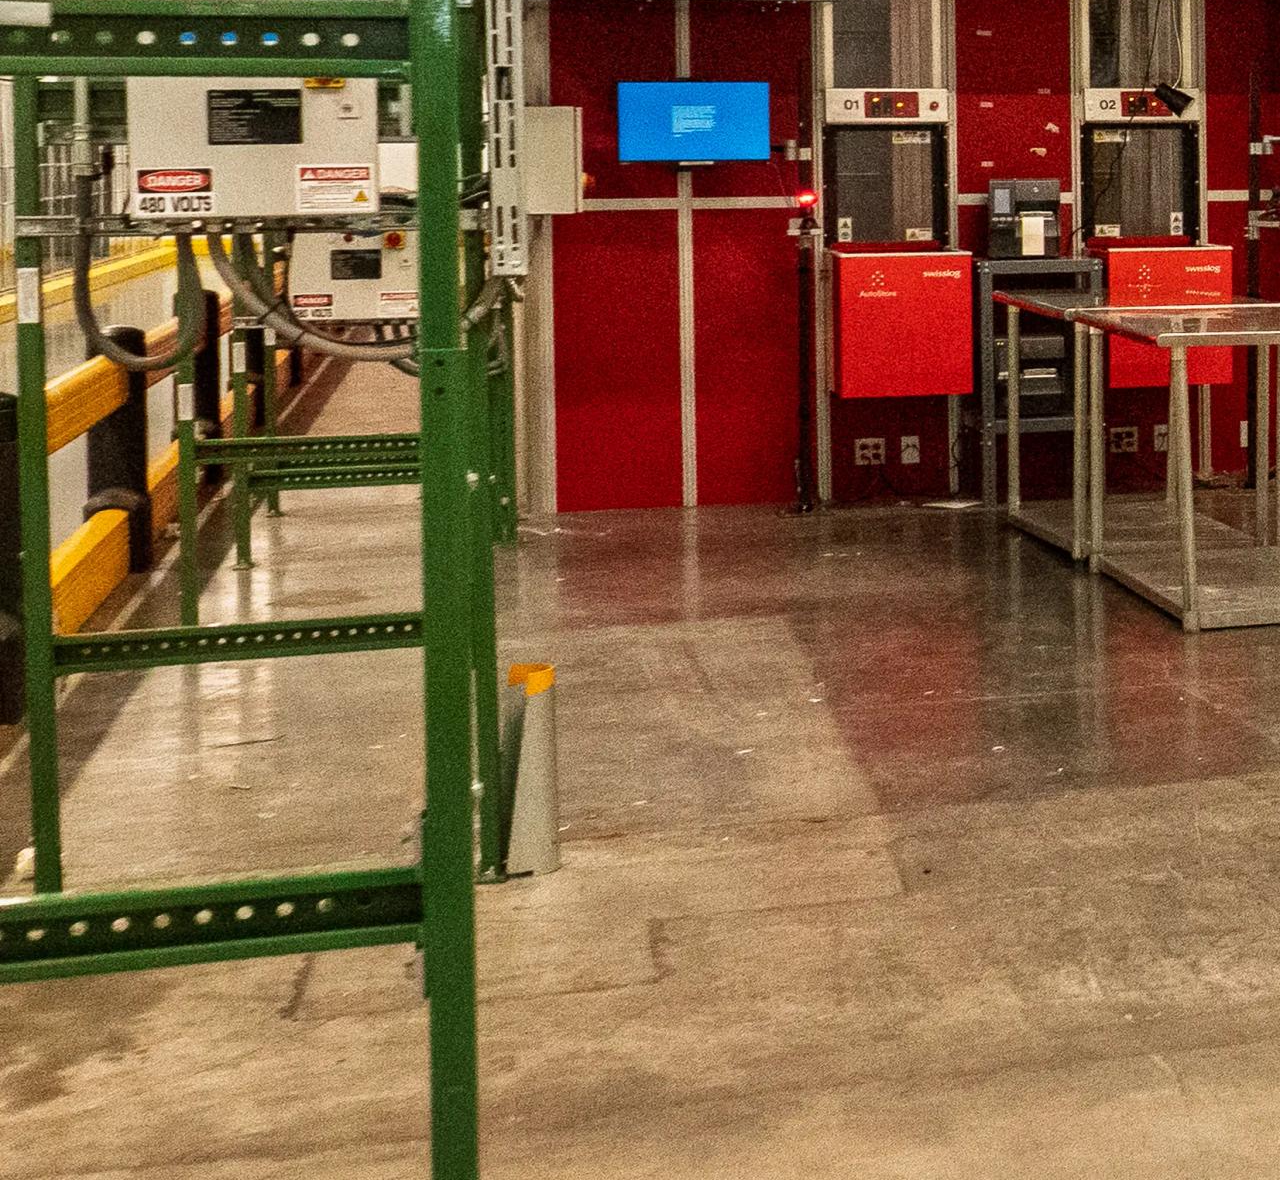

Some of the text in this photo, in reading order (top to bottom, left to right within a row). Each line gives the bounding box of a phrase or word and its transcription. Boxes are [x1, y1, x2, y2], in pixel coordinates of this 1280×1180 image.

[843, 99, 859, 110] 01
[1100, 99, 1117, 110] 02
[317, 169, 369, 179] DANGER
[147, 174, 202, 186] DANGER
[139, 195, 213, 213] 480 VOLTS
[922, 269, 961, 279] swisslog
